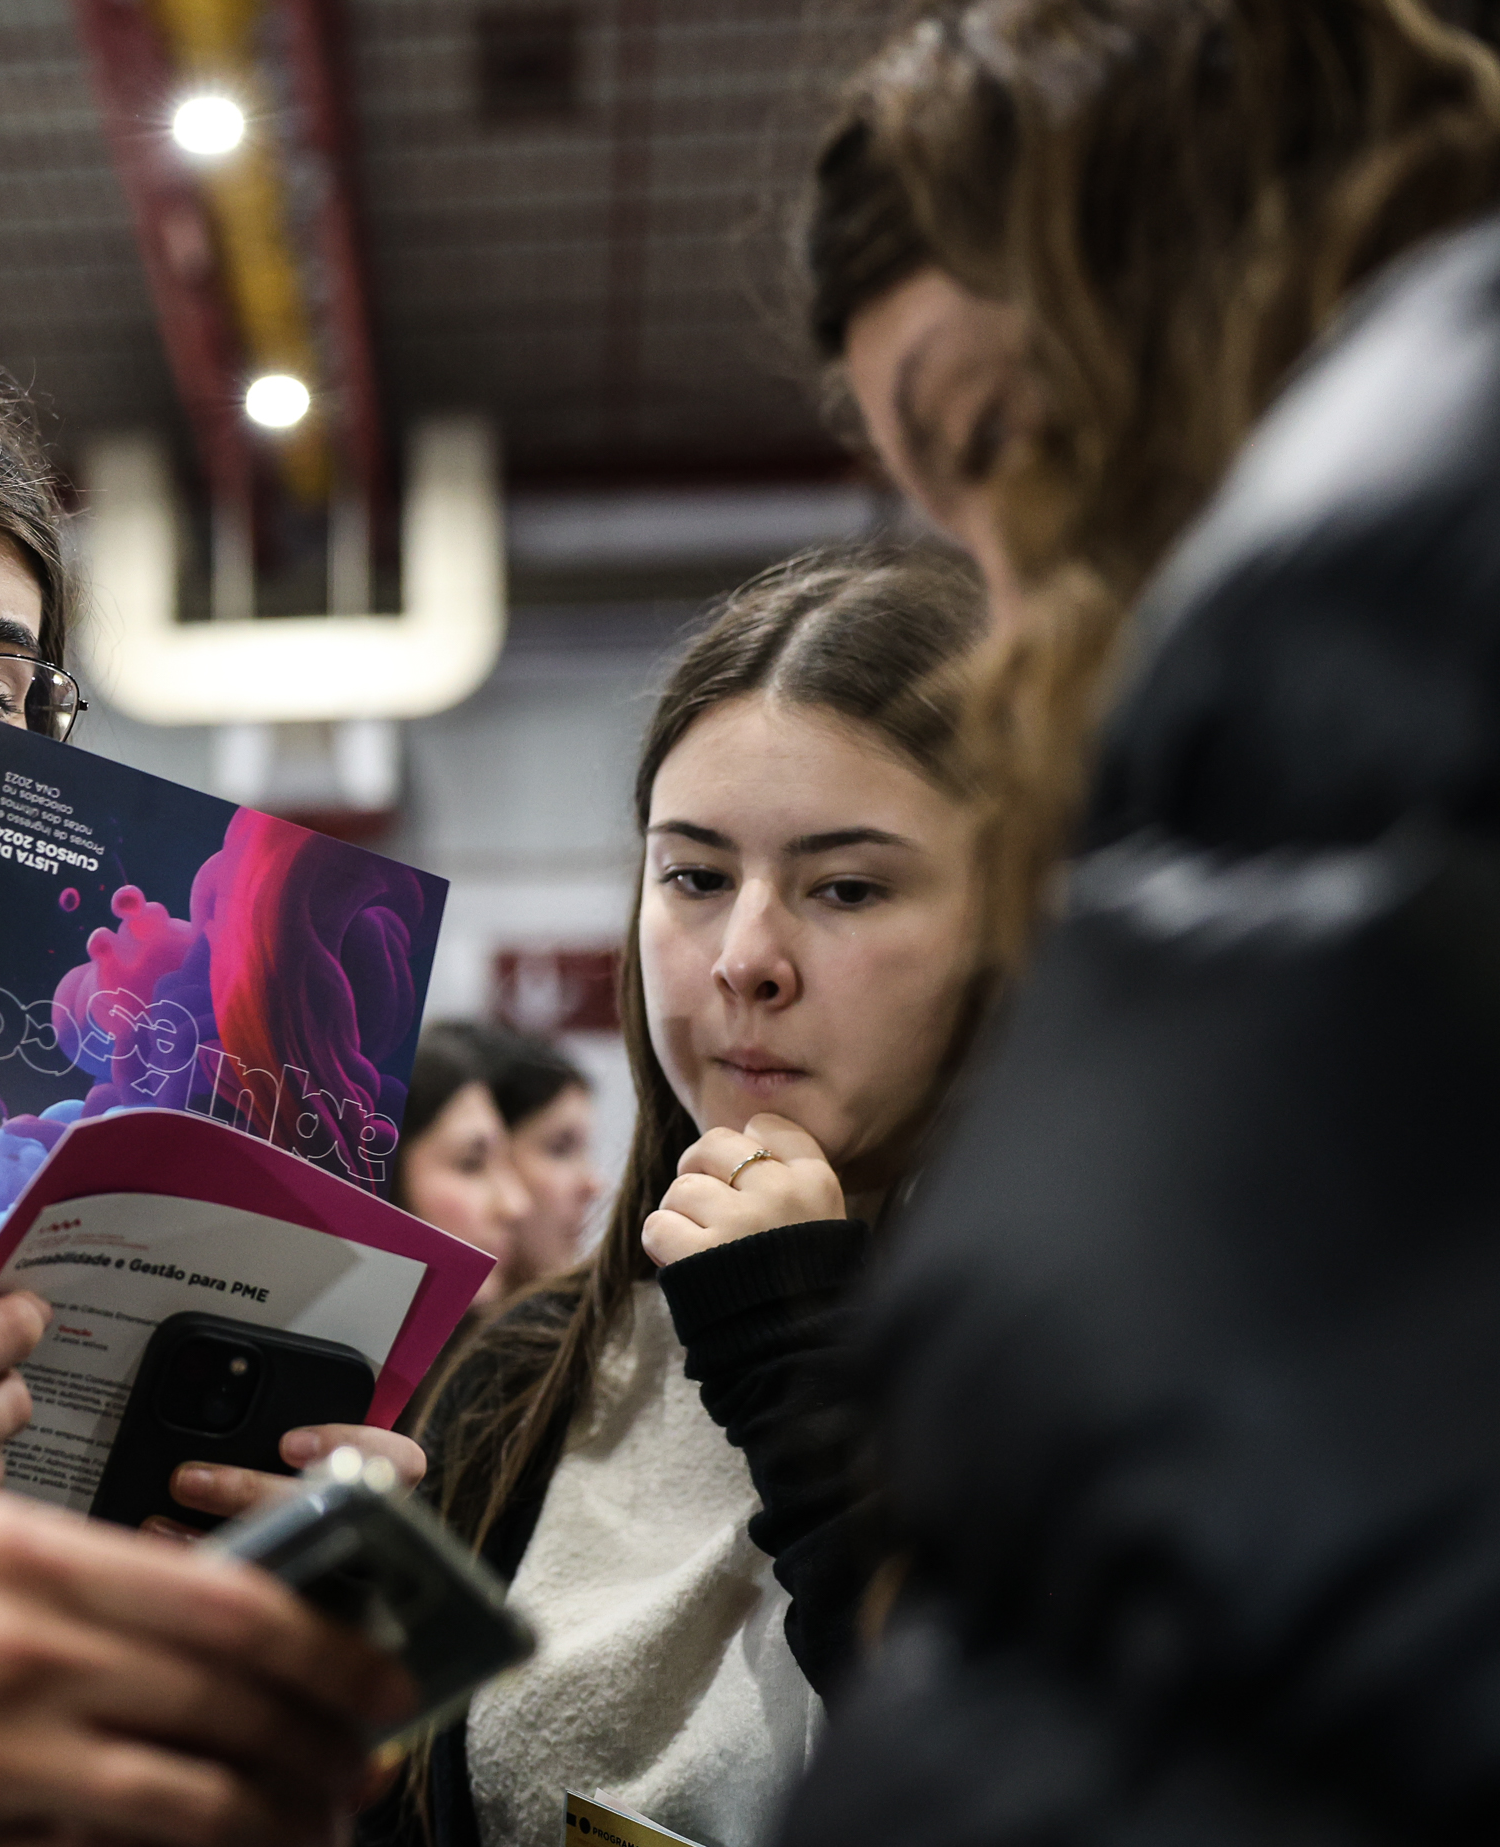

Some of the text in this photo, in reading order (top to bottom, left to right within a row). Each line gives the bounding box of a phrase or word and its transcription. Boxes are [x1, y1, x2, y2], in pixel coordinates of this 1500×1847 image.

[4, 771, 61, 798] CNA 2023
[2, 784, 74, 815] colocados no
[0, 796, 93, 835] notas dos últimos
[53, 829, 68, 840] de
[69, 834, 105, 855] Provas
[16, 848, 59, 875] LISTA
[35, 840, 99, 872] CURSOS
[15, 1251, 270, 1303] Contabilidade e Gestão para PME
[593, 1827, 639, 1847] PROGRAM
